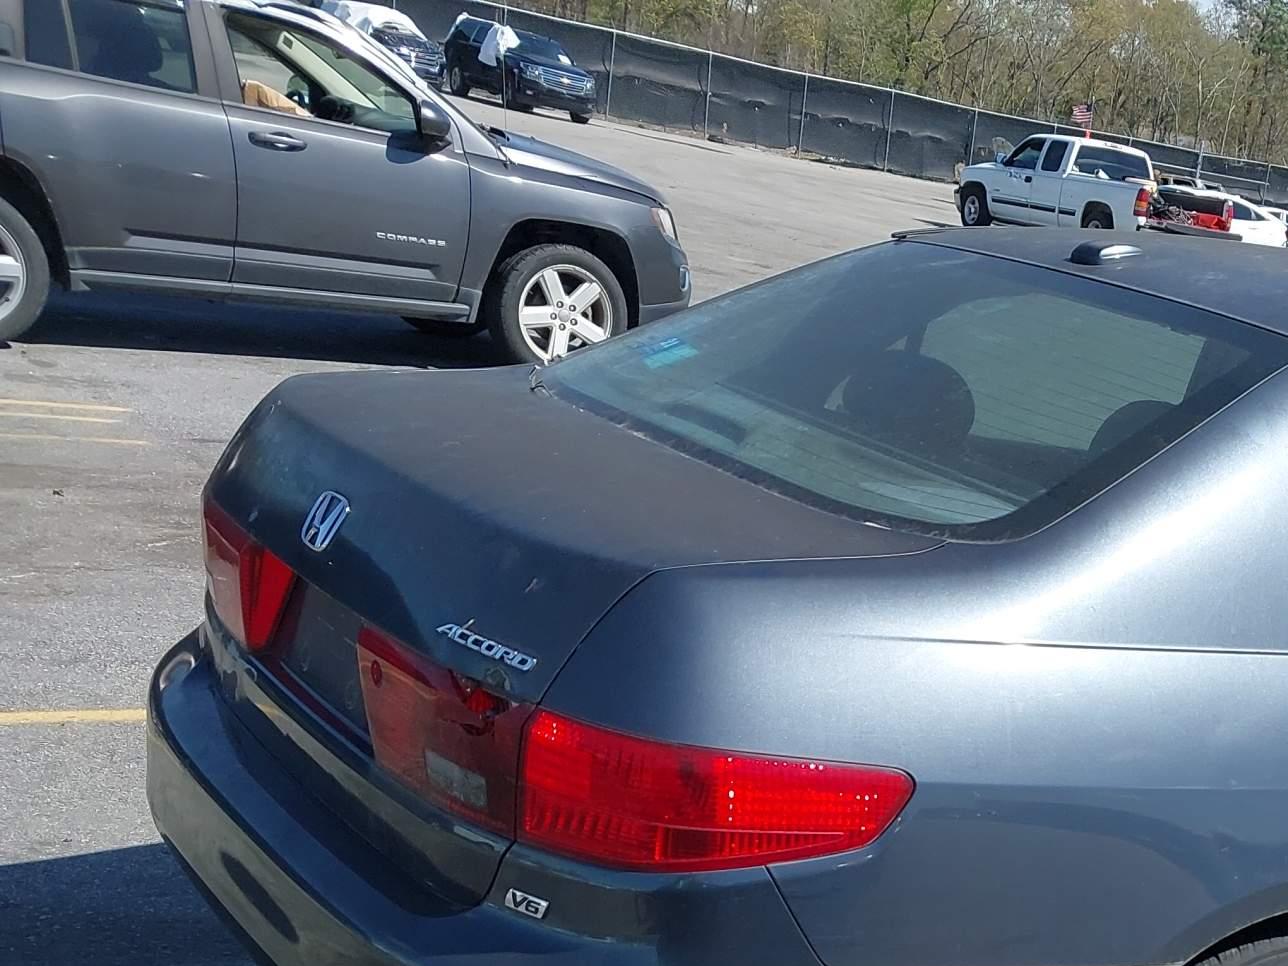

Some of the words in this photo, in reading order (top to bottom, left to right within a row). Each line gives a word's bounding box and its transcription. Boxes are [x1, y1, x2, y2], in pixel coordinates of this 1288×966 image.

[376, 231, 446, 247] COMPASS
[436, 623, 537, 671] ACCORD
[510, 889, 543, 916] V6
